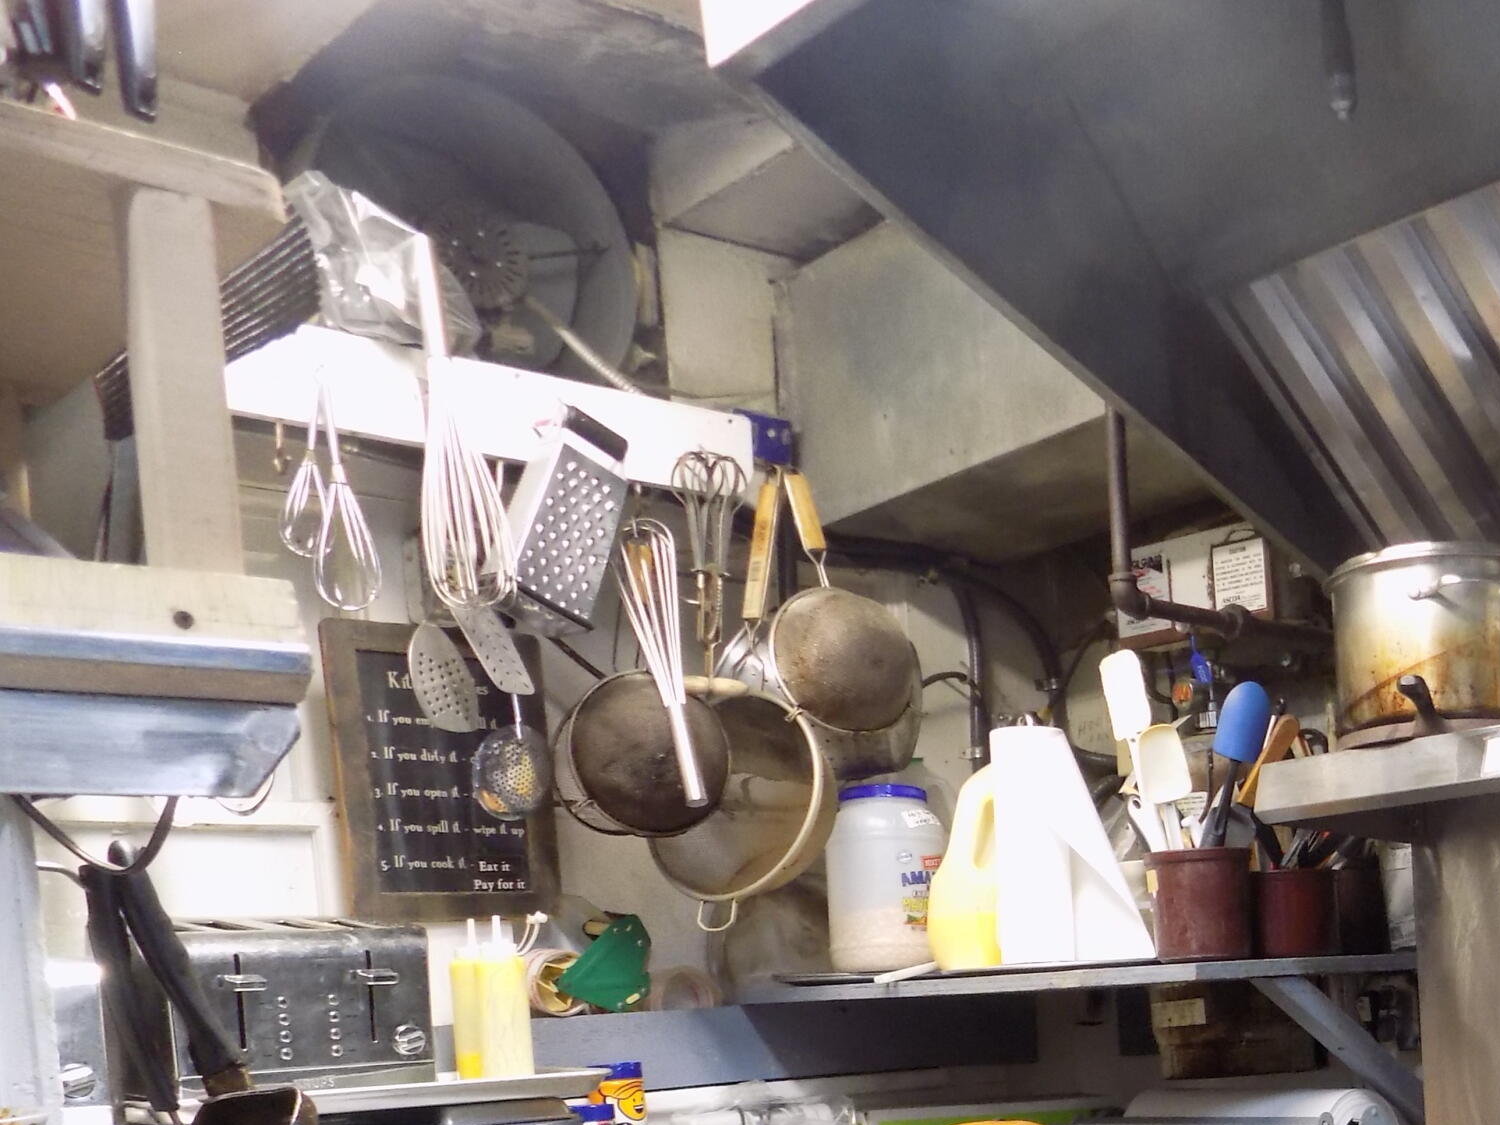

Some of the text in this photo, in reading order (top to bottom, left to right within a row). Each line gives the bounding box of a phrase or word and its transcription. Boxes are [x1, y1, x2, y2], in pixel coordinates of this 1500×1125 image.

[378, 709, 391, 723] If
[392, 716, 412, 725] you
[383, 746, 395, 759] If
[397, 753, 417, 762] you
[420, 748, 445, 764] dirty
[386, 782, 399, 795] If
[401, 788, 420, 798] you
[424, 789, 448, 800] open
[389, 818, 401, 832] If
[404, 823, 423, 835] you
[427, 820, 449, 836] spill
[473, 824, 496, 838] wipe
[511, 826, 525, 839] up
[394, 854, 406, 868] If
[407, 859, 428, 870] you
[431, 855, 455, 869] cook
[479, 860, 499, 872] Eat
[501, 860, 511, 872] it
[473, 877, 526, 891] Pay for it
